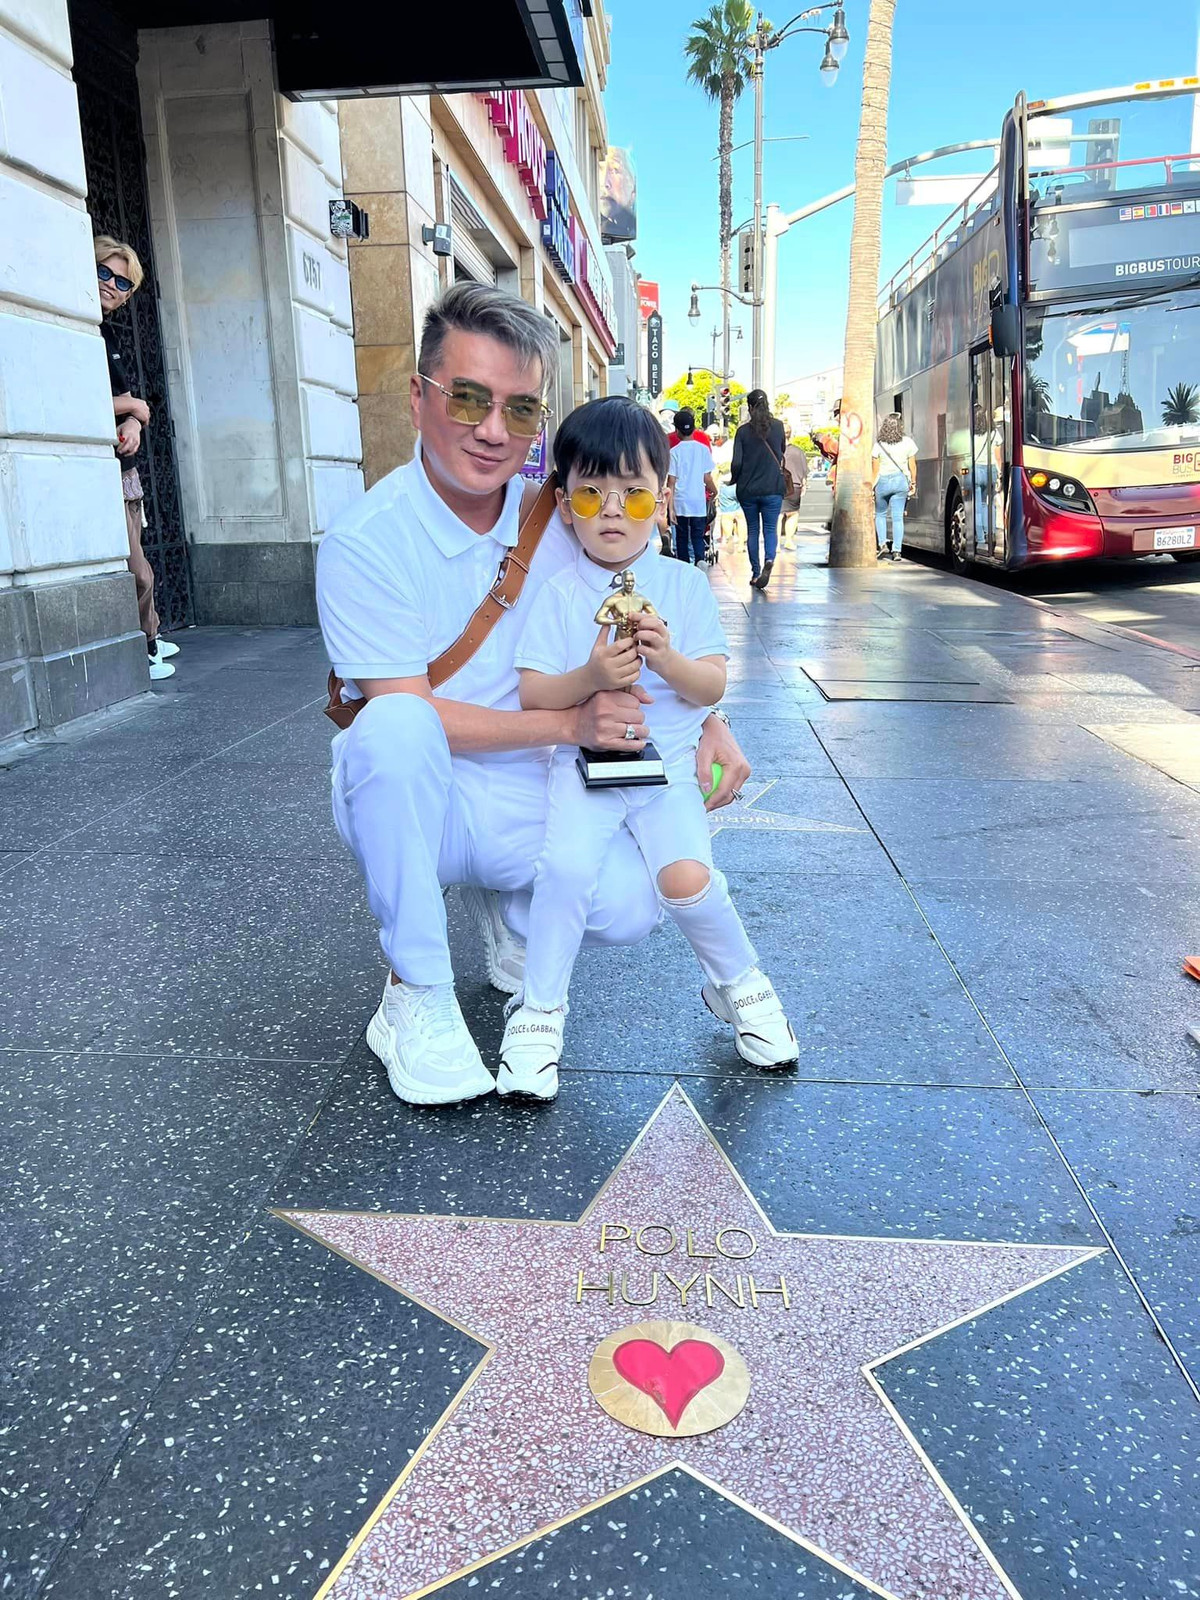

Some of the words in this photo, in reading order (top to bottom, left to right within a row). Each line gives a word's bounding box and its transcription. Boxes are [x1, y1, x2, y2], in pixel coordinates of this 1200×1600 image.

[302, 251, 321, 290] 6757
[1172, 464, 1193, 475] BUS
[1173, 453, 1194, 465] BIG
[599, 1223, 759, 1260] POLO
[575, 1269, 791, 1310] HUYNH
